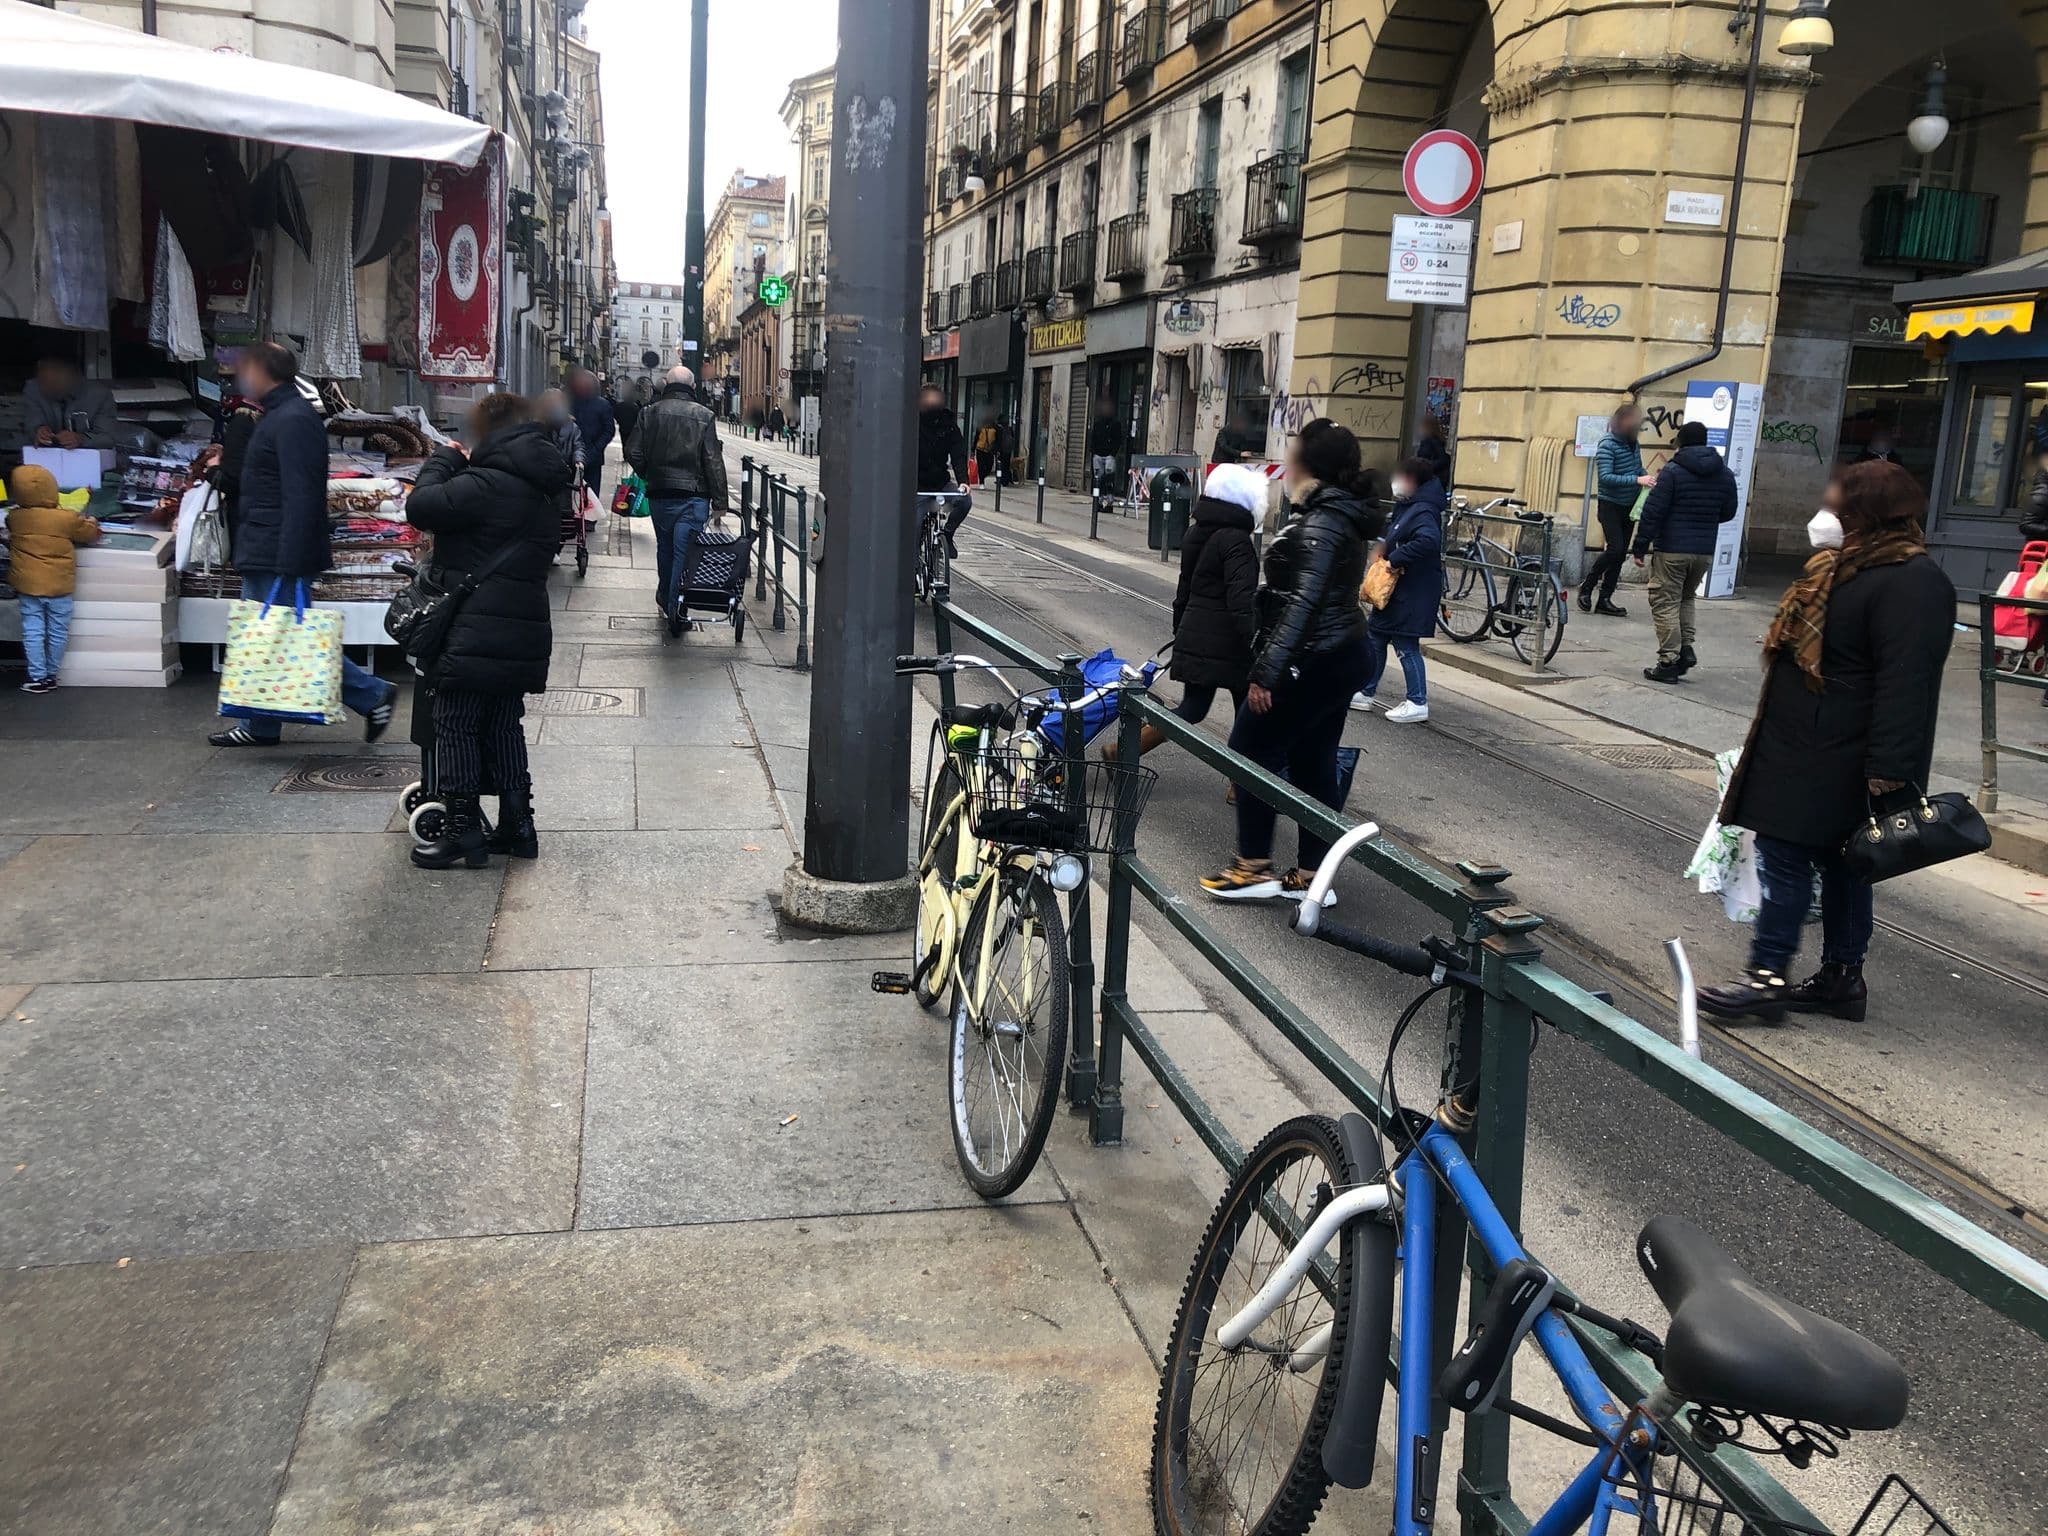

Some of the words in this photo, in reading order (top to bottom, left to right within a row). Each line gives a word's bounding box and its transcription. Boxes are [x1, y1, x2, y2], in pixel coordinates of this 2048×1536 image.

[1403, 257, 1416, 267] 30
[1427, 259, 1449, 269] 0-24
[1868, 316, 1906, 333] SAL
[1033, 319, 1082, 351] TRATTORIA
